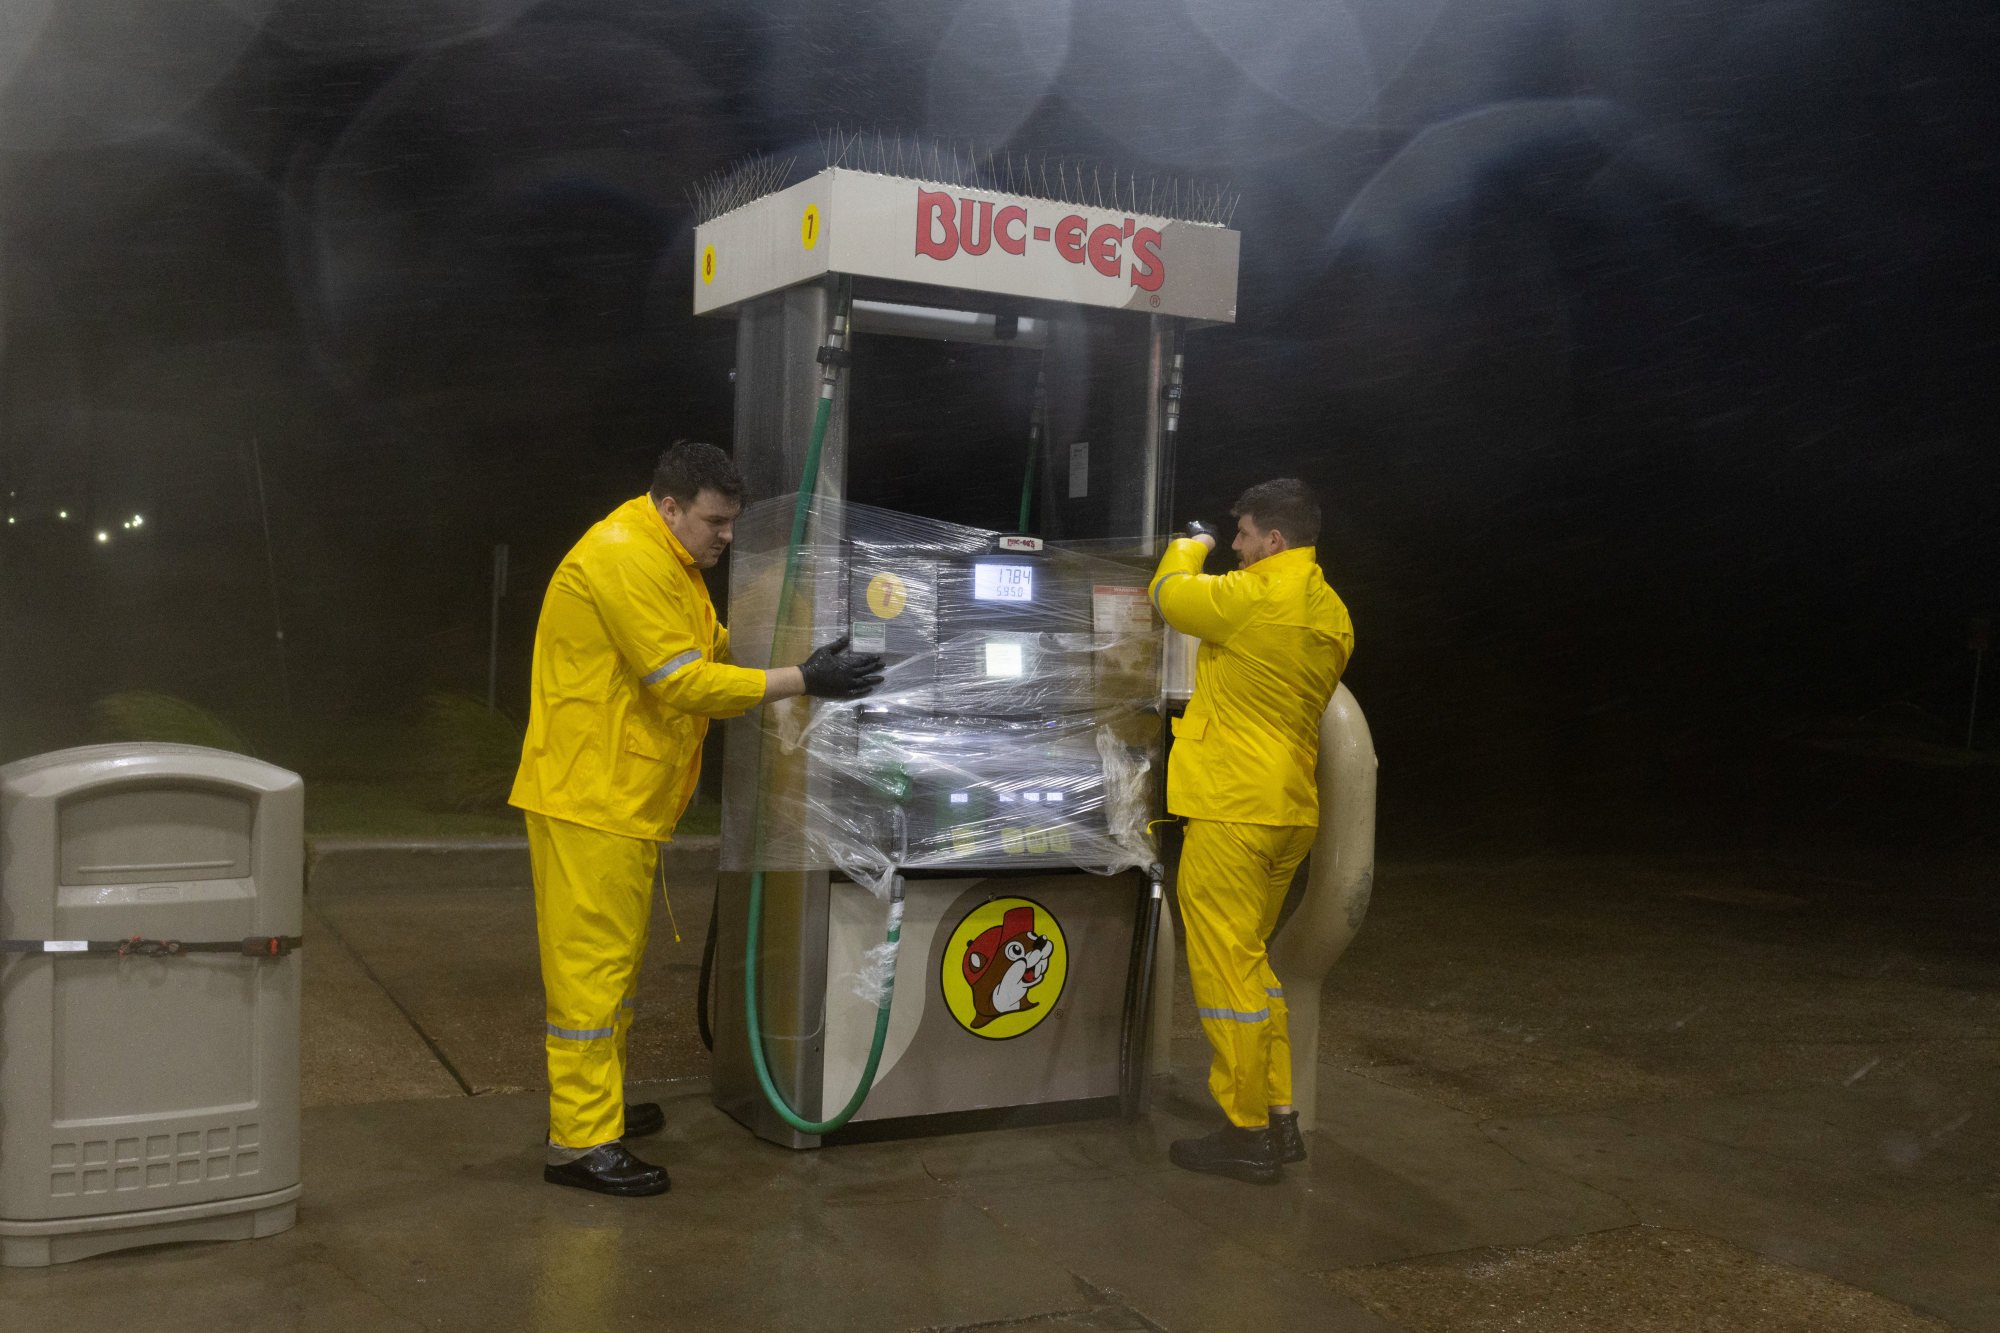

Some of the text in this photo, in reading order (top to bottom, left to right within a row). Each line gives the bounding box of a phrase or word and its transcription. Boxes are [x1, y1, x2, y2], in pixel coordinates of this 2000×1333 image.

[807, 213, 814, 239] 7
[915, 186, 1165, 292] BUC-EE'S
[882, 582, 893, 607] 7
